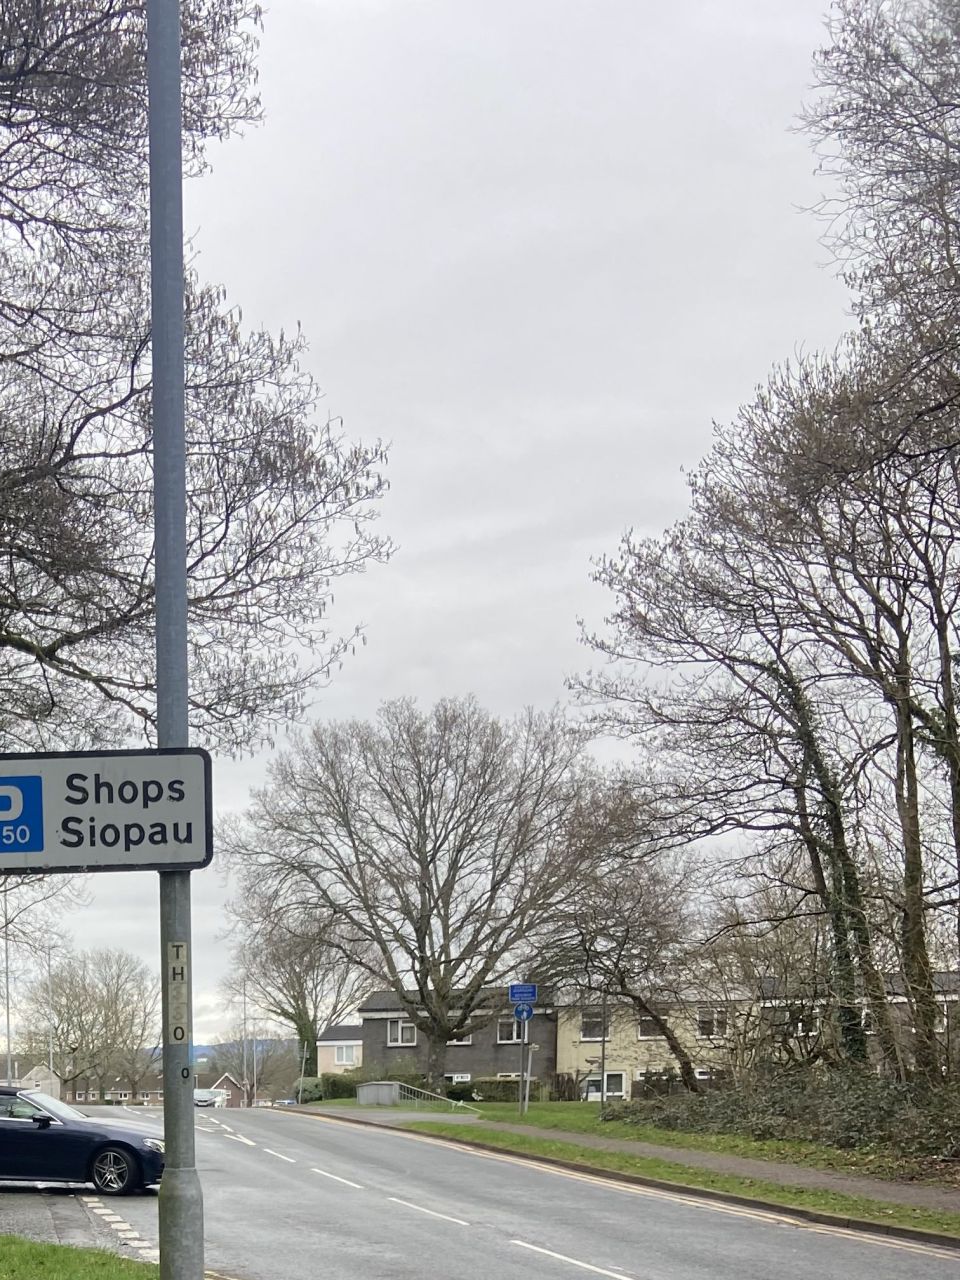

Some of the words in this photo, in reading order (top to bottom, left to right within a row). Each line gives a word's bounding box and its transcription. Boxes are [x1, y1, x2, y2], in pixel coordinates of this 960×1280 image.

[65, 773, 185, 808] Shops
[2, 825, 30, 845] 50
[60, 816, 192, 851] Siopau
